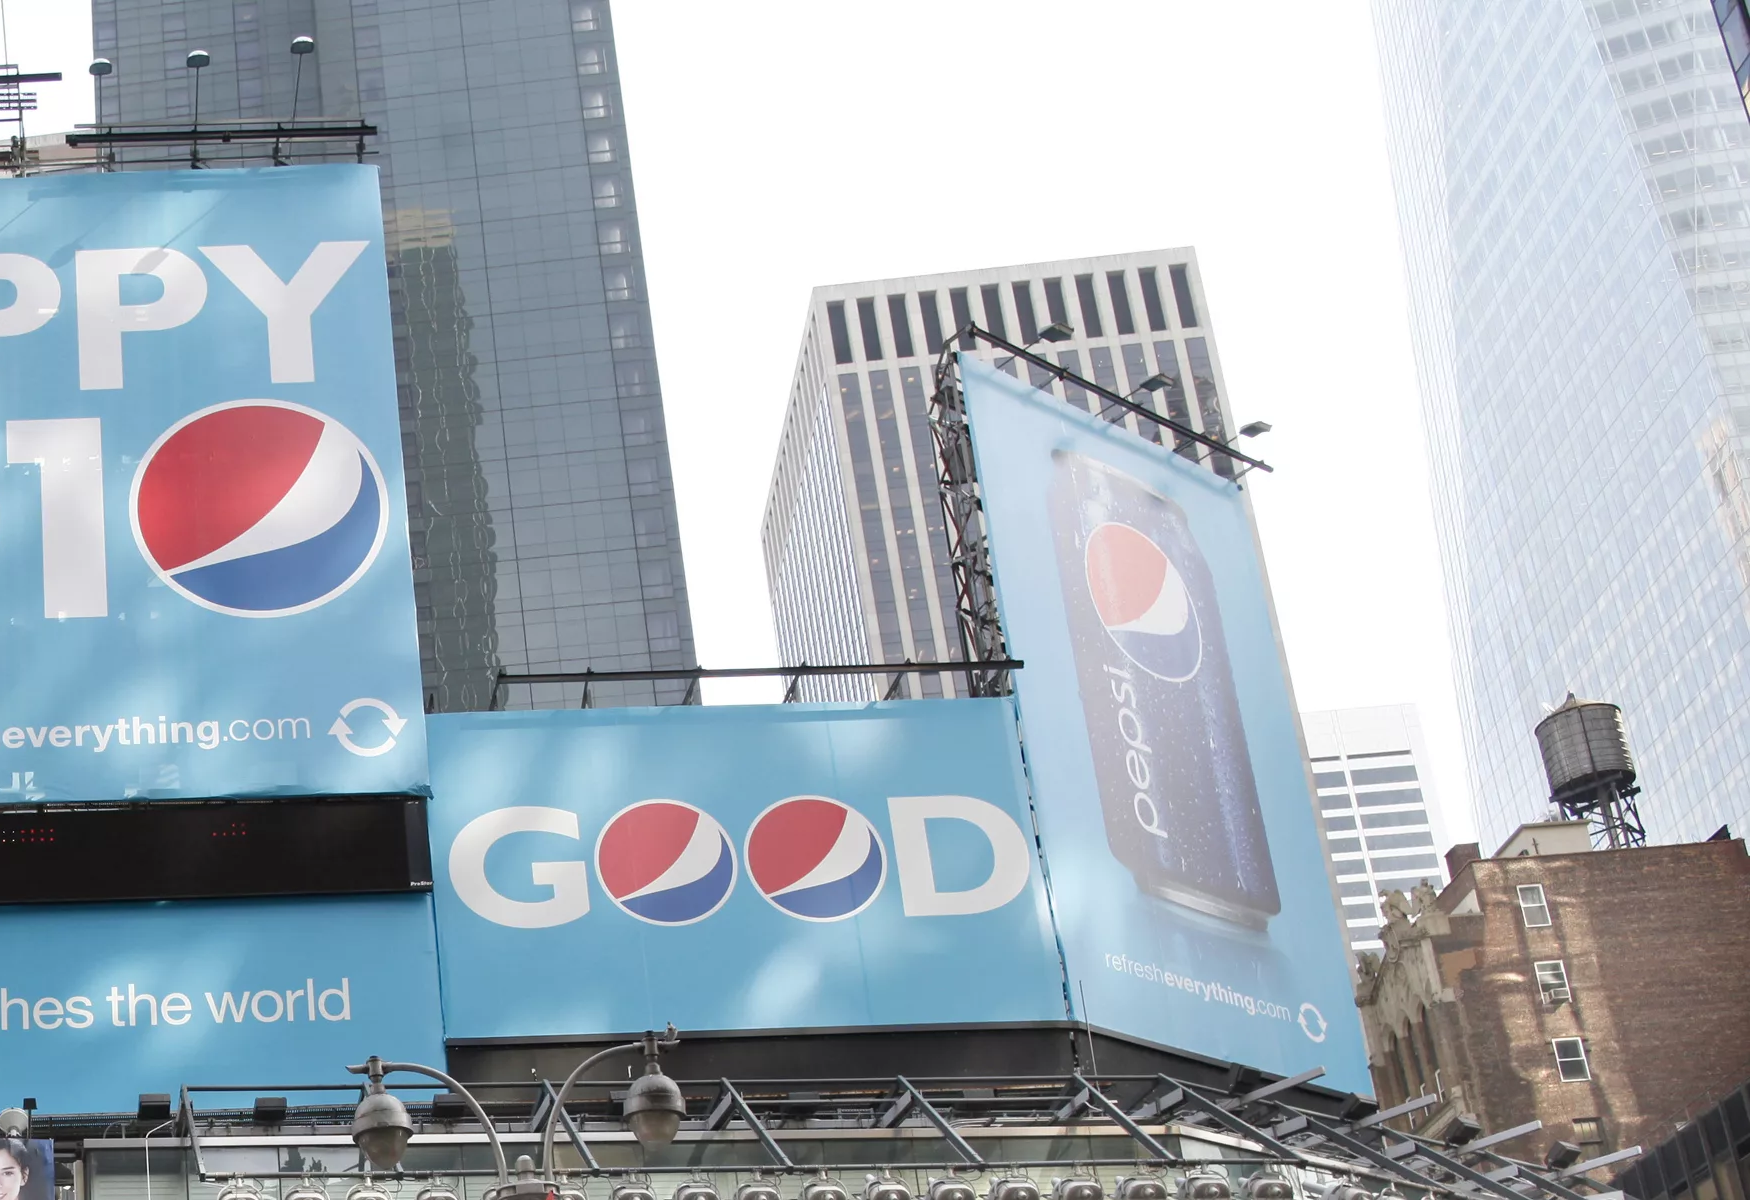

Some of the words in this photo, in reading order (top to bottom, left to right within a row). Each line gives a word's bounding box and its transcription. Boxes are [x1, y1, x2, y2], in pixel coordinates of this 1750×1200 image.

[1104, 662, 1167, 839] pepsi
[106, 983, 192, 1027] the
[204, 977, 351, 1024] world
[1105, 952, 1292, 1023] refresheverything.com
